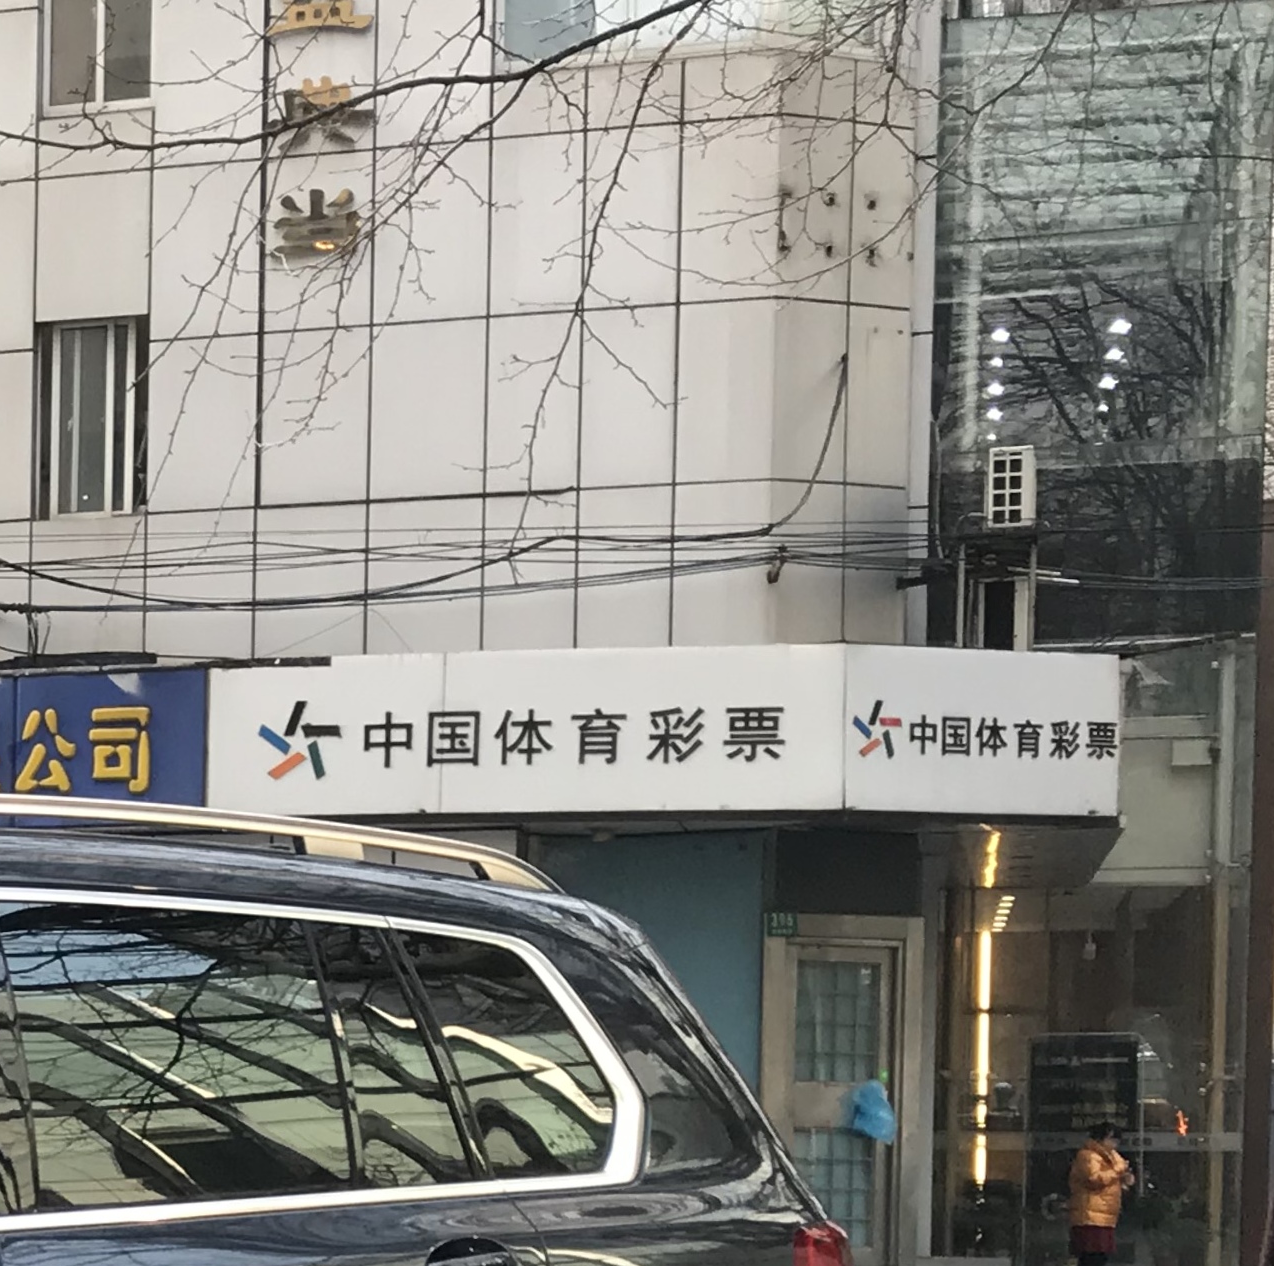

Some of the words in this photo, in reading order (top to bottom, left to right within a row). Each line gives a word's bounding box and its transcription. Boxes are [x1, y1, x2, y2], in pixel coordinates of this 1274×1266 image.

[363, 706, 785, 768] 中国体育彩票
[909, 714, 1118, 760] 中国体育彩票
